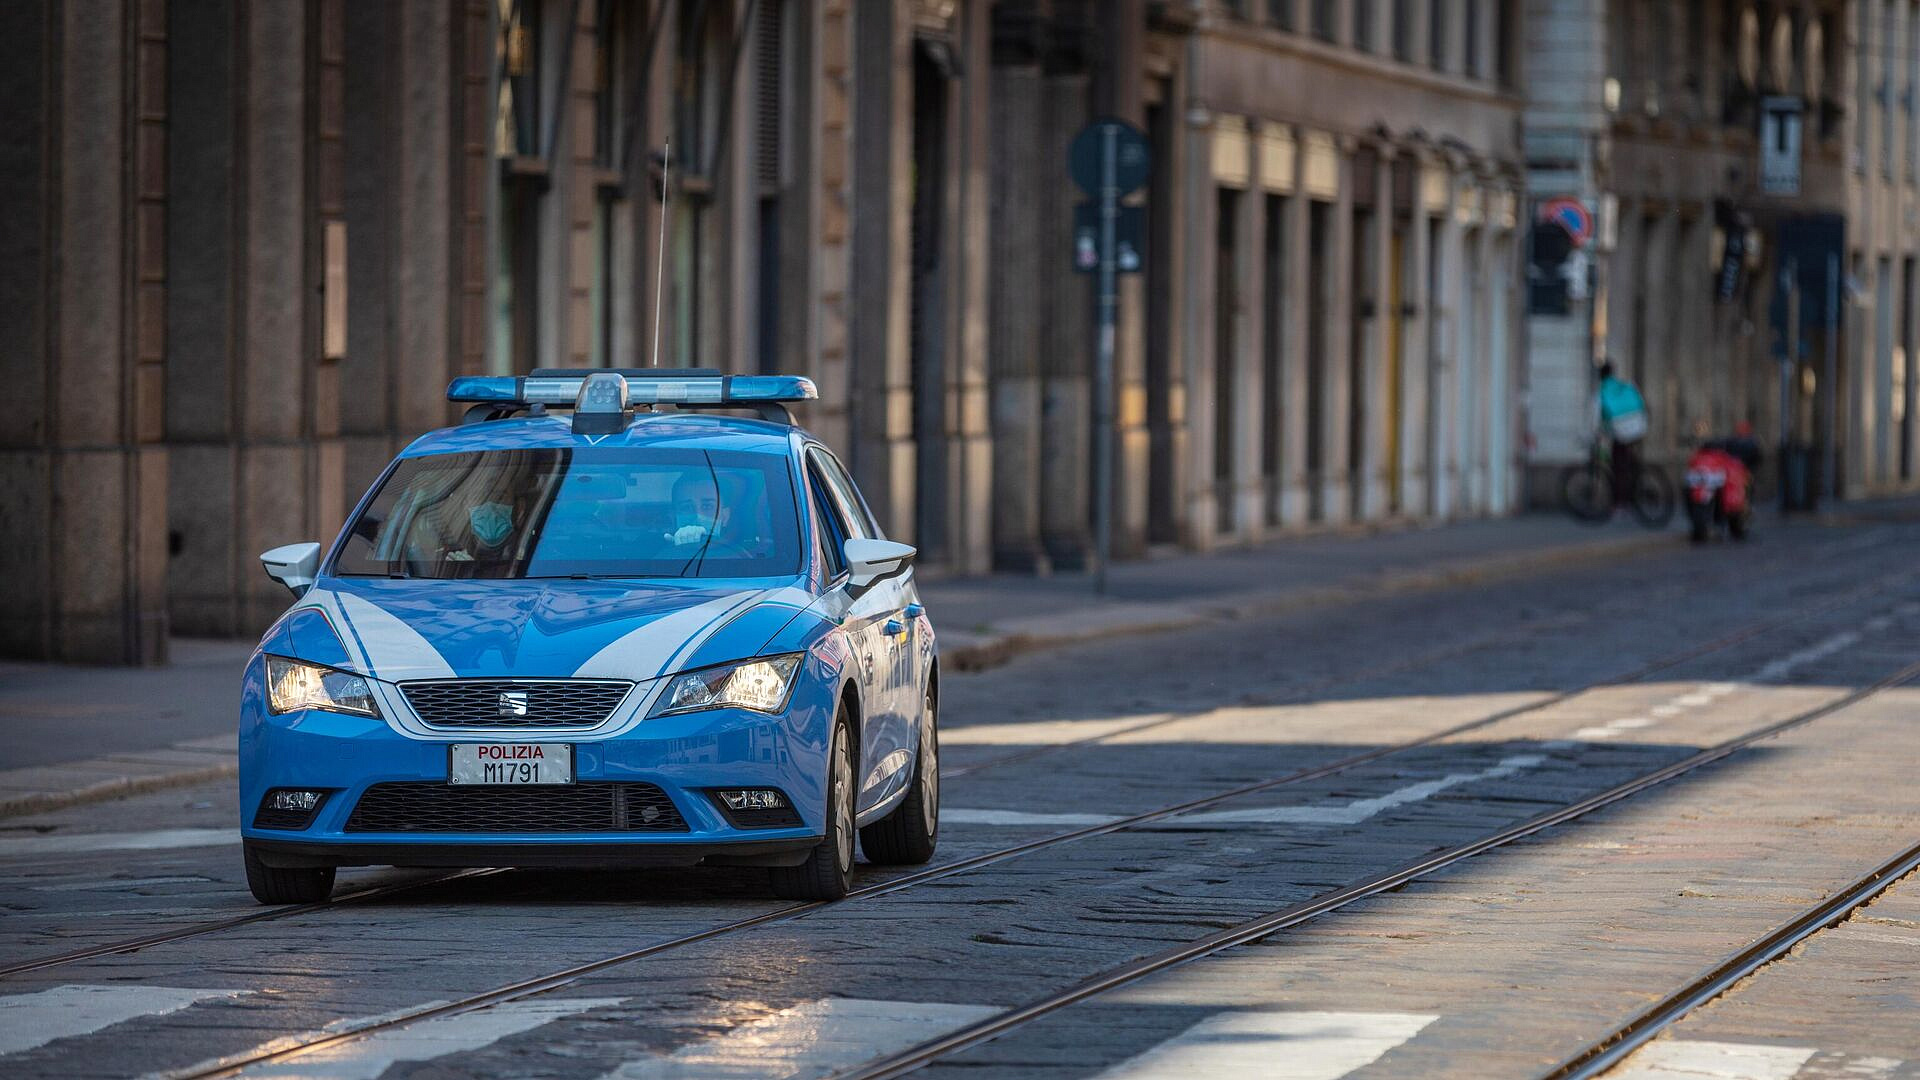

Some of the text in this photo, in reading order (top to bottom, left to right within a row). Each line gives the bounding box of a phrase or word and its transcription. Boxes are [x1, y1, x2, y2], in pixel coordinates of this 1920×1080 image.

[1768, 108, 1799, 153] T
[478, 745, 544, 759] POLIZIA
[484, 762, 539, 783] M1791
